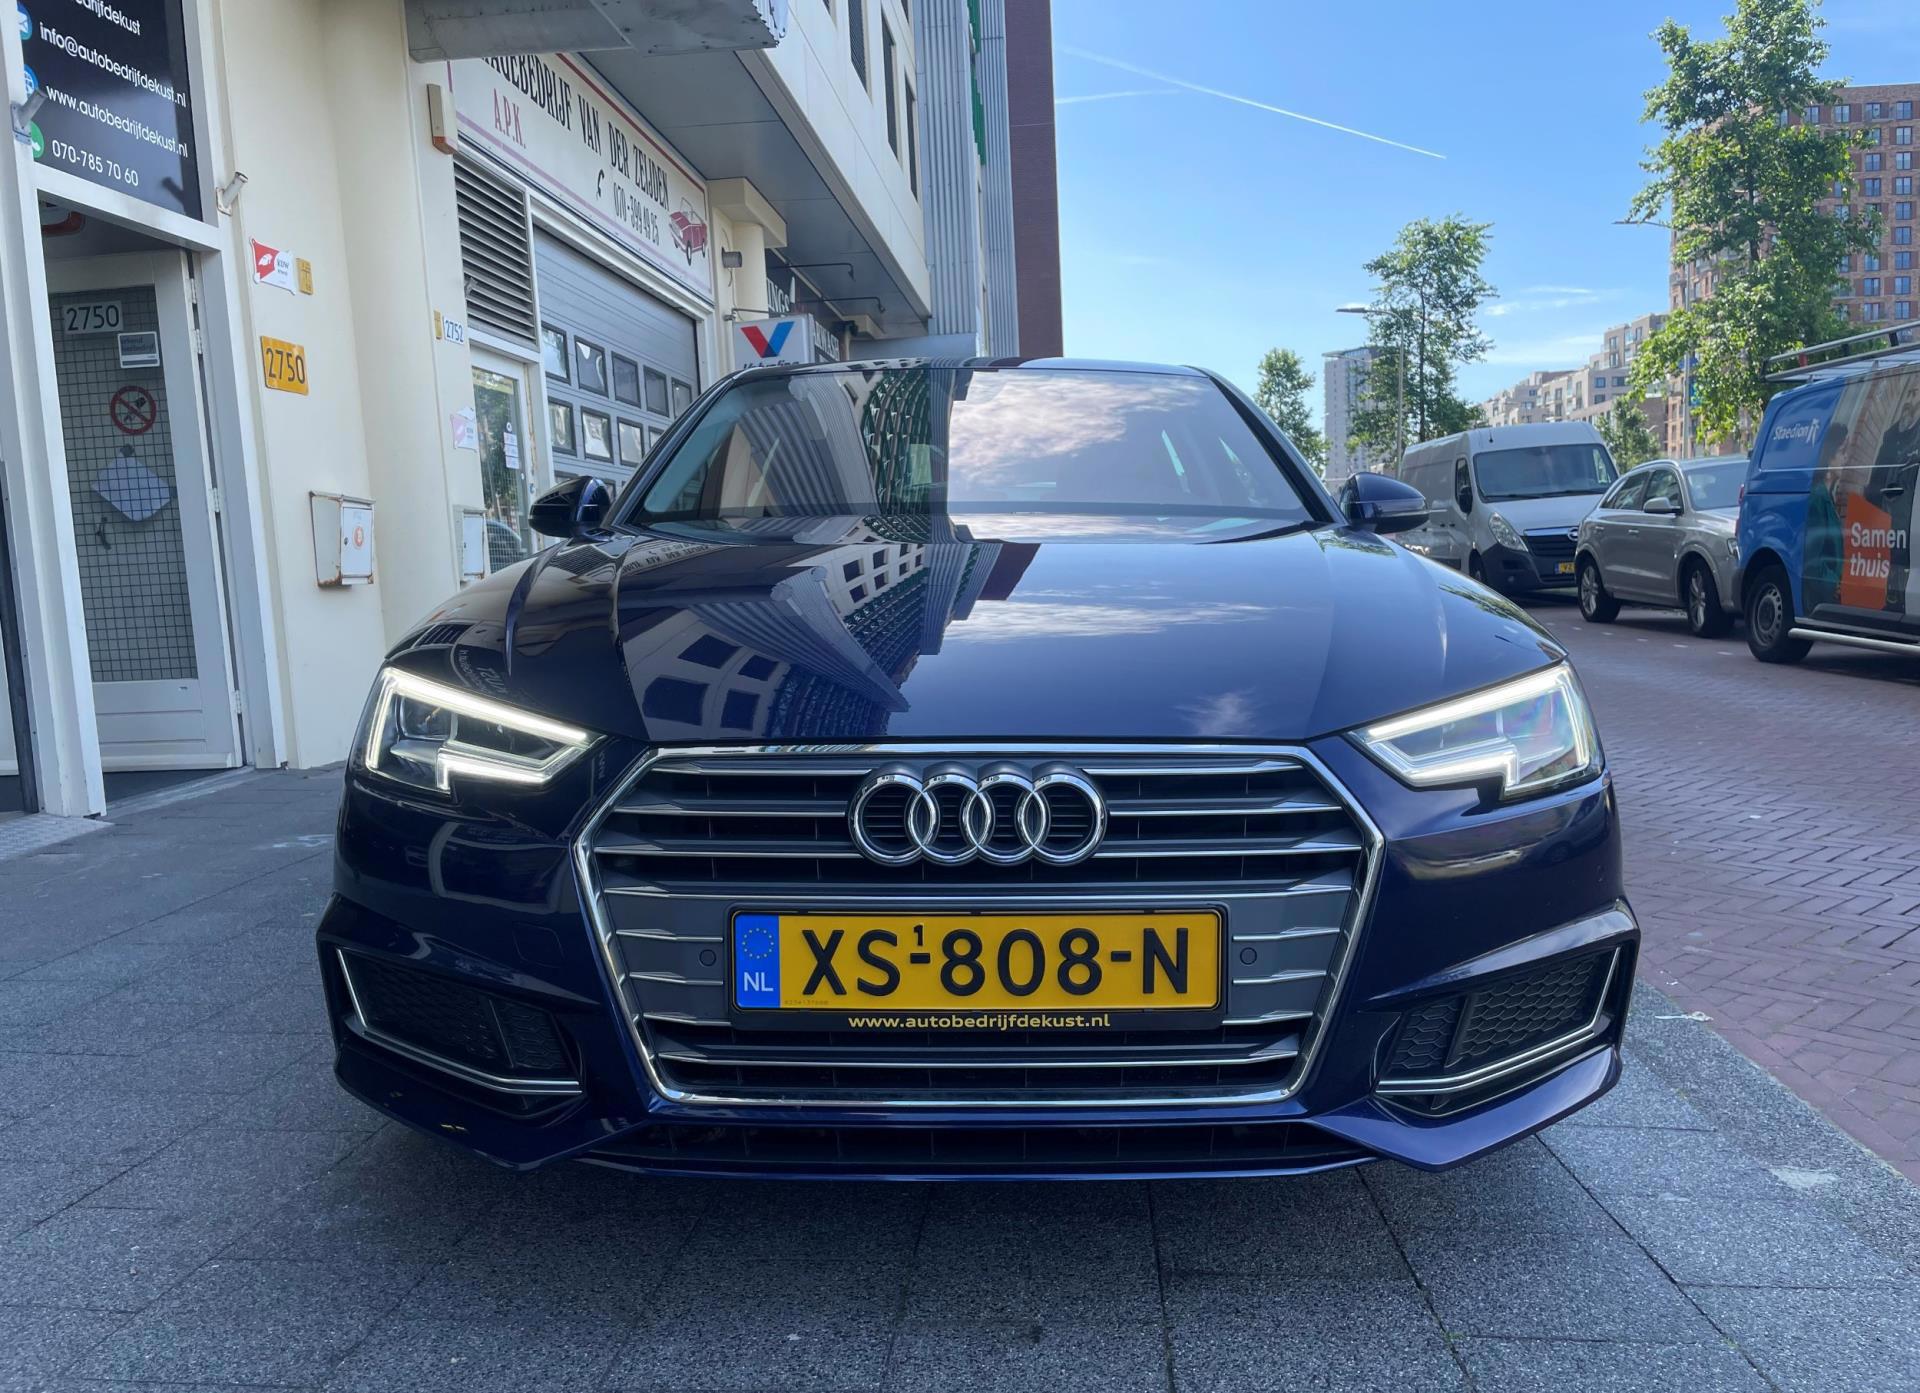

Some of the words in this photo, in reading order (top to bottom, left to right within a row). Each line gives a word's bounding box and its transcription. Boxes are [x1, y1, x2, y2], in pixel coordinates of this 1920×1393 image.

[39, 21, 186, 107] info@autobedrijfdekust.nl
[46, 85, 188, 158] www.autobedrijfdekust.nl
[492, 86, 527, 149] A.P.K.
[577, 93, 602, 157] VAN
[607, 120, 630, 180] DER
[52, 139, 103, 173] 070-785
[106, 160, 121, 180] 70
[124, 167, 139, 187] 60
[66, 304, 120, 331] 2750
[445, 319, 464, 343] 2752
[265, 347, 306, 385] 2750
[1851, 522, 1907, 549] Samen
[1850, 551, 1890, 578] thuis
[743, 971, 774, 993] NL
[848, 1013, 1111, 1032] www.autobedrijfdekust.nl
